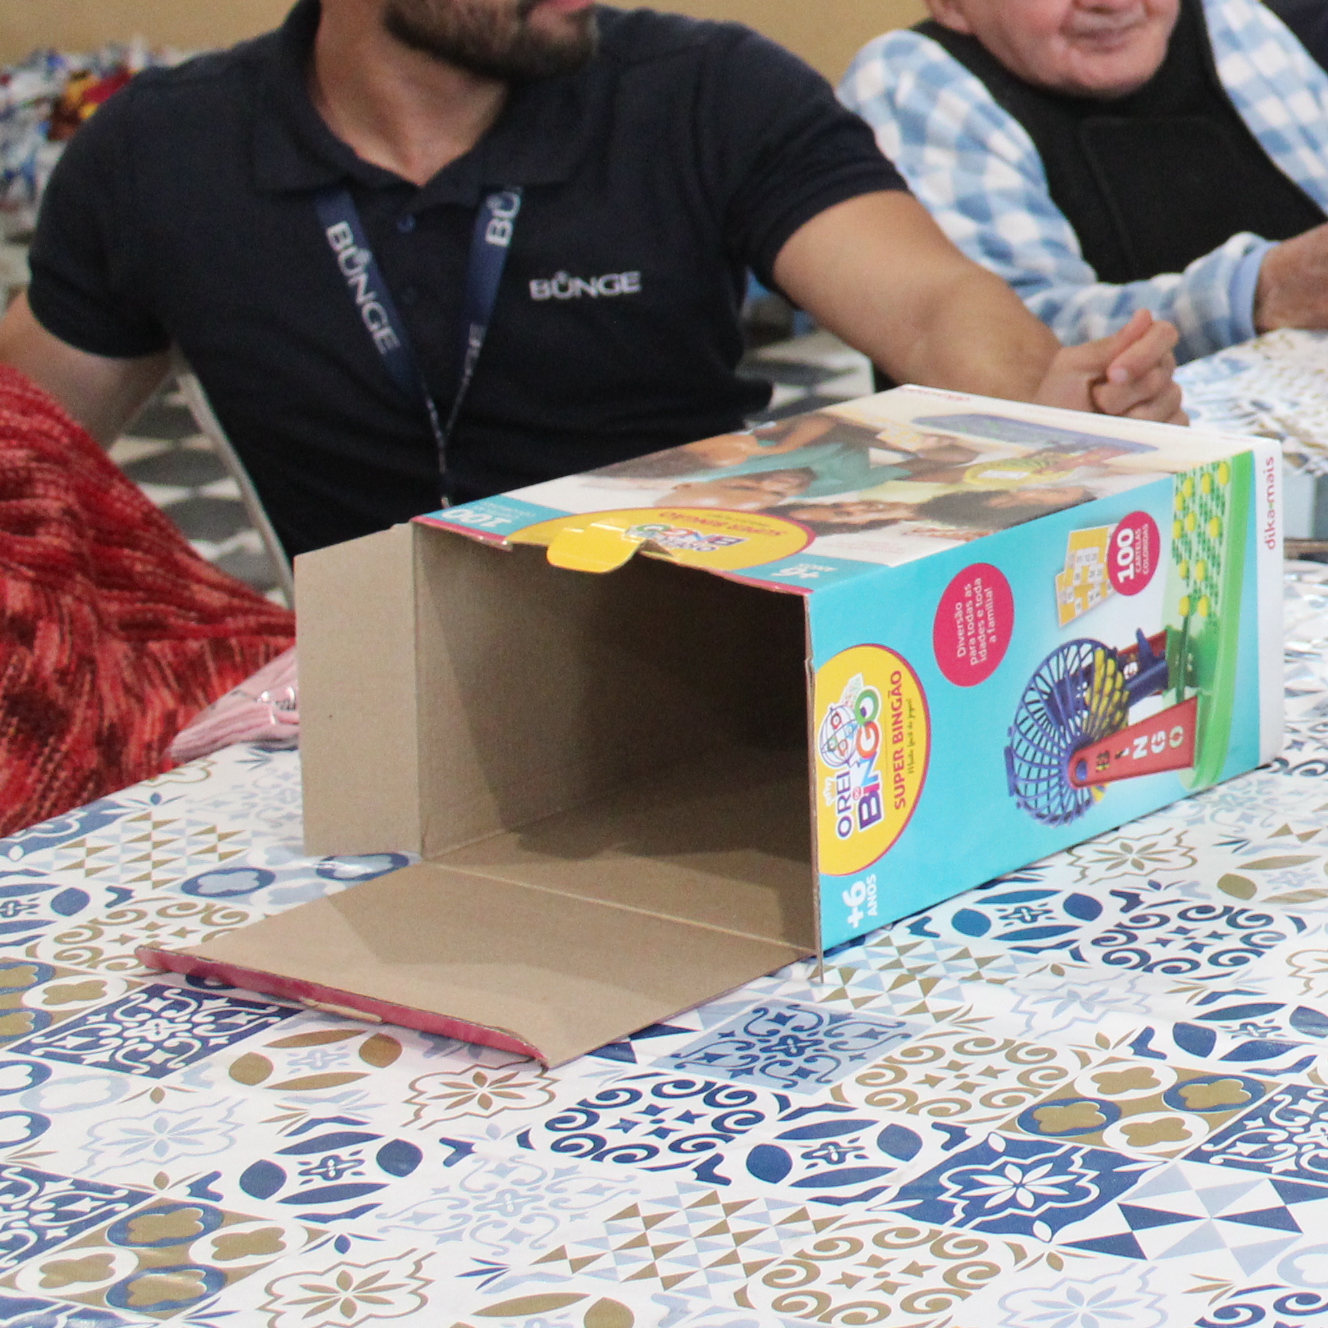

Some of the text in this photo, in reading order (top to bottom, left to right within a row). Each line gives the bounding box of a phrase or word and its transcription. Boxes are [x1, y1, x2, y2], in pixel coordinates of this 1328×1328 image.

[1116, 527, 1135, 583] 100
[1142, 523, 1150, 575] COLORIDAS
[954, 602, 967, 658] Diversão
[964, 583, 979, 666] para todas as
[973, 577, 988, 662] idades e toda
[989, 635, 997, 643] a
[888, 670, 907, 810] SUPER BINGÃO
[843, 880, 865, 928] +6
[866, 873, 877, 916] ANOS
